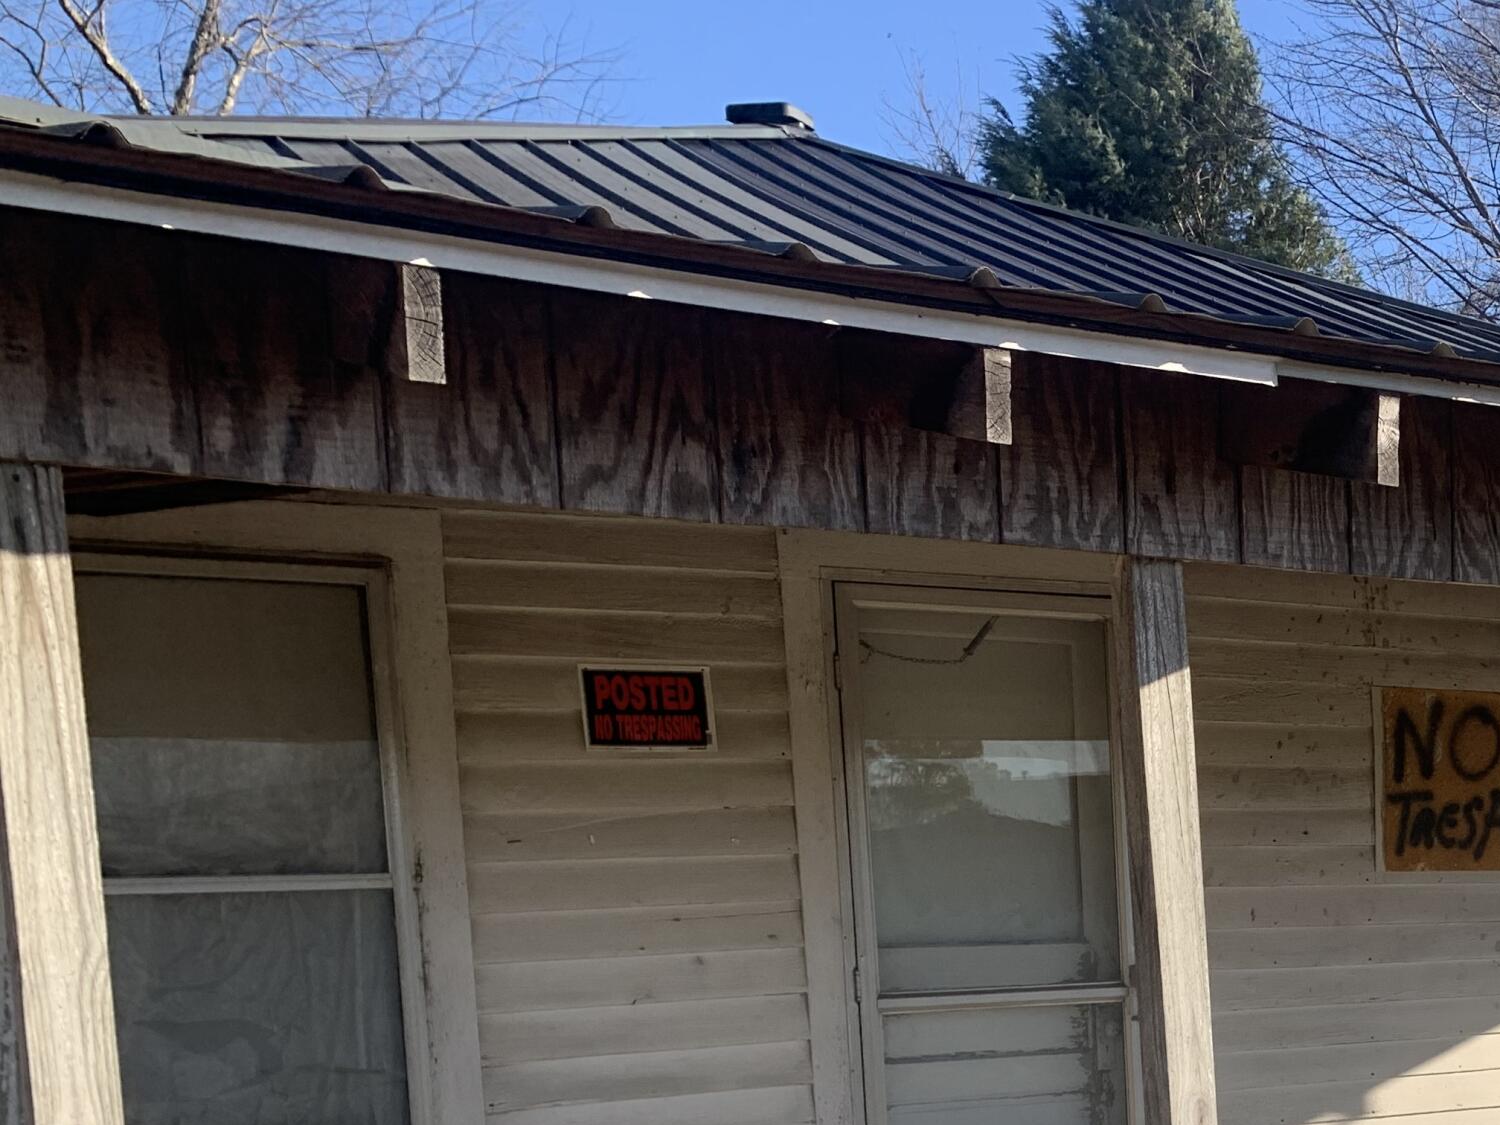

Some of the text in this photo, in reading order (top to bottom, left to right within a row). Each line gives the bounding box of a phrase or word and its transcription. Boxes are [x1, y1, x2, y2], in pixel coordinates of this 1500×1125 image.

[594, 673, 695, 711] POSTED
[594, 714, 702, 742] NO TRESPASSING
